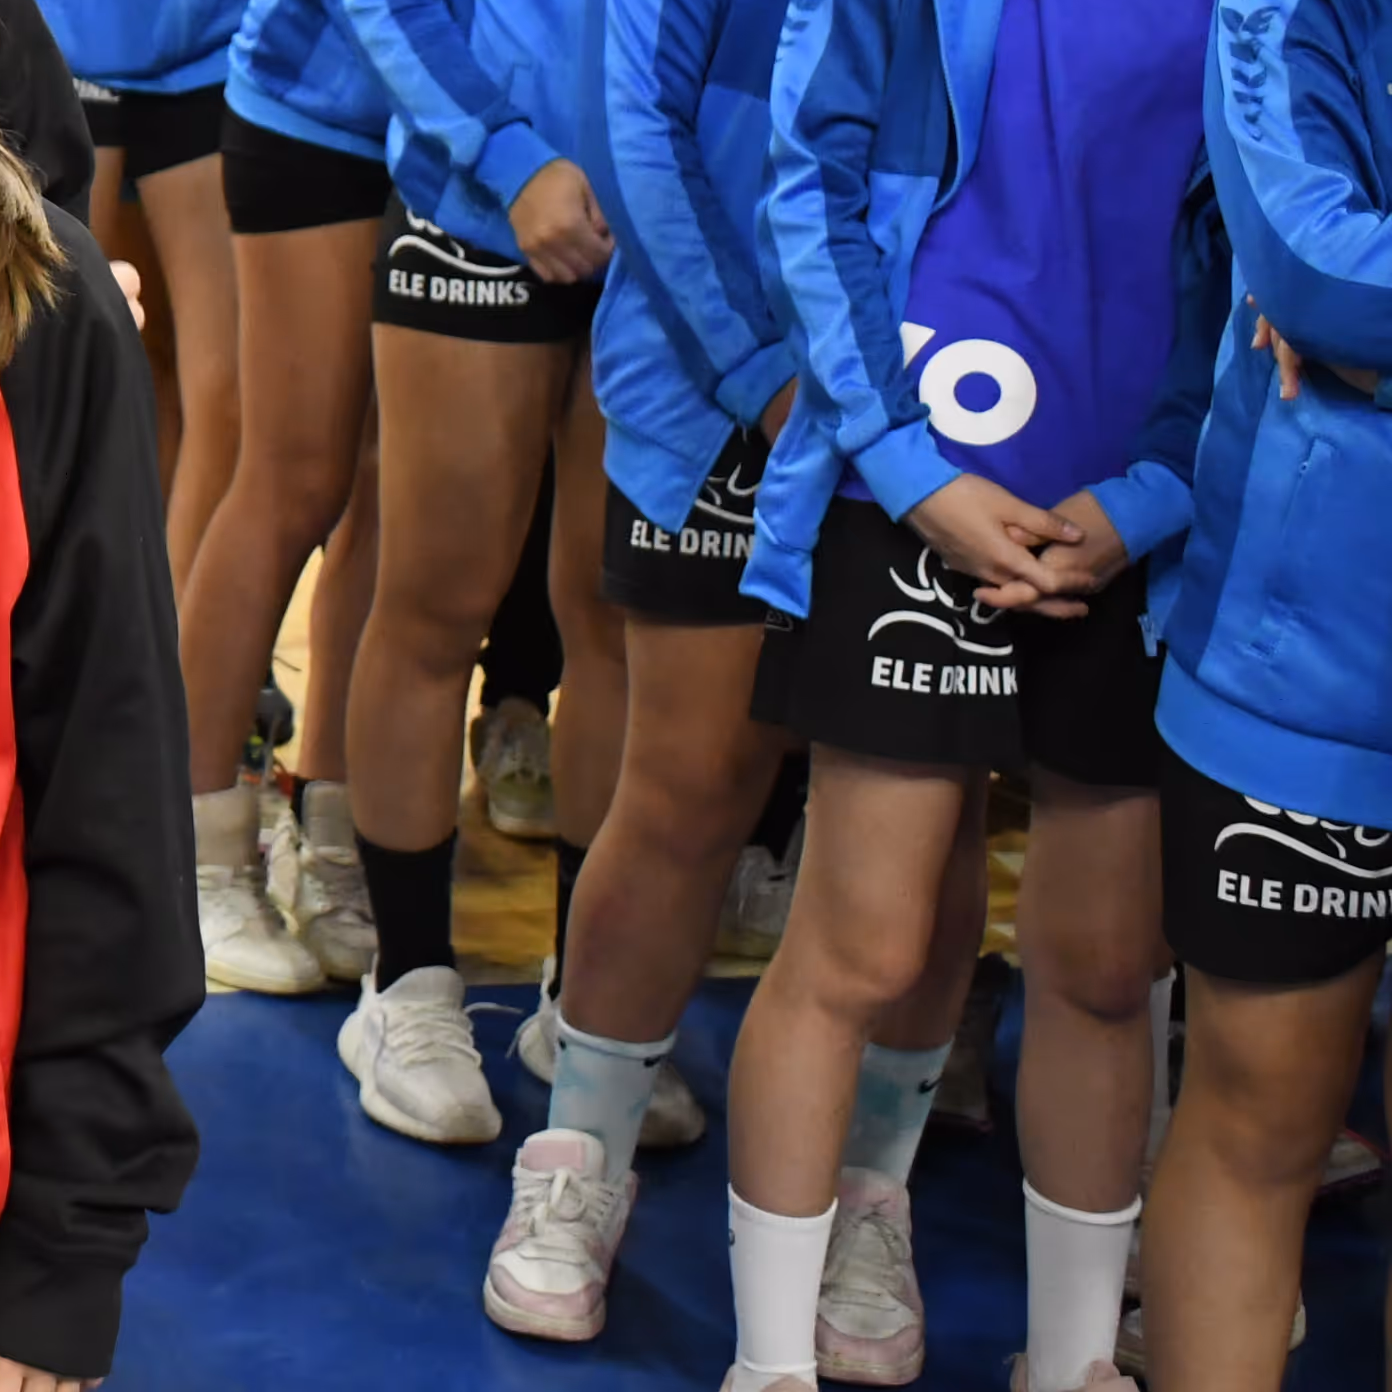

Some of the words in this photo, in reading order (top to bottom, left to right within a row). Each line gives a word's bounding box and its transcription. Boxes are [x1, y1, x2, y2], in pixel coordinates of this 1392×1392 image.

[388, 268, 426, 298] ELE
[429, 275, 531, 306] DRINKS
[871, 656, 933, 693] ELE
[1217, 869, 1284, 911] ELE
